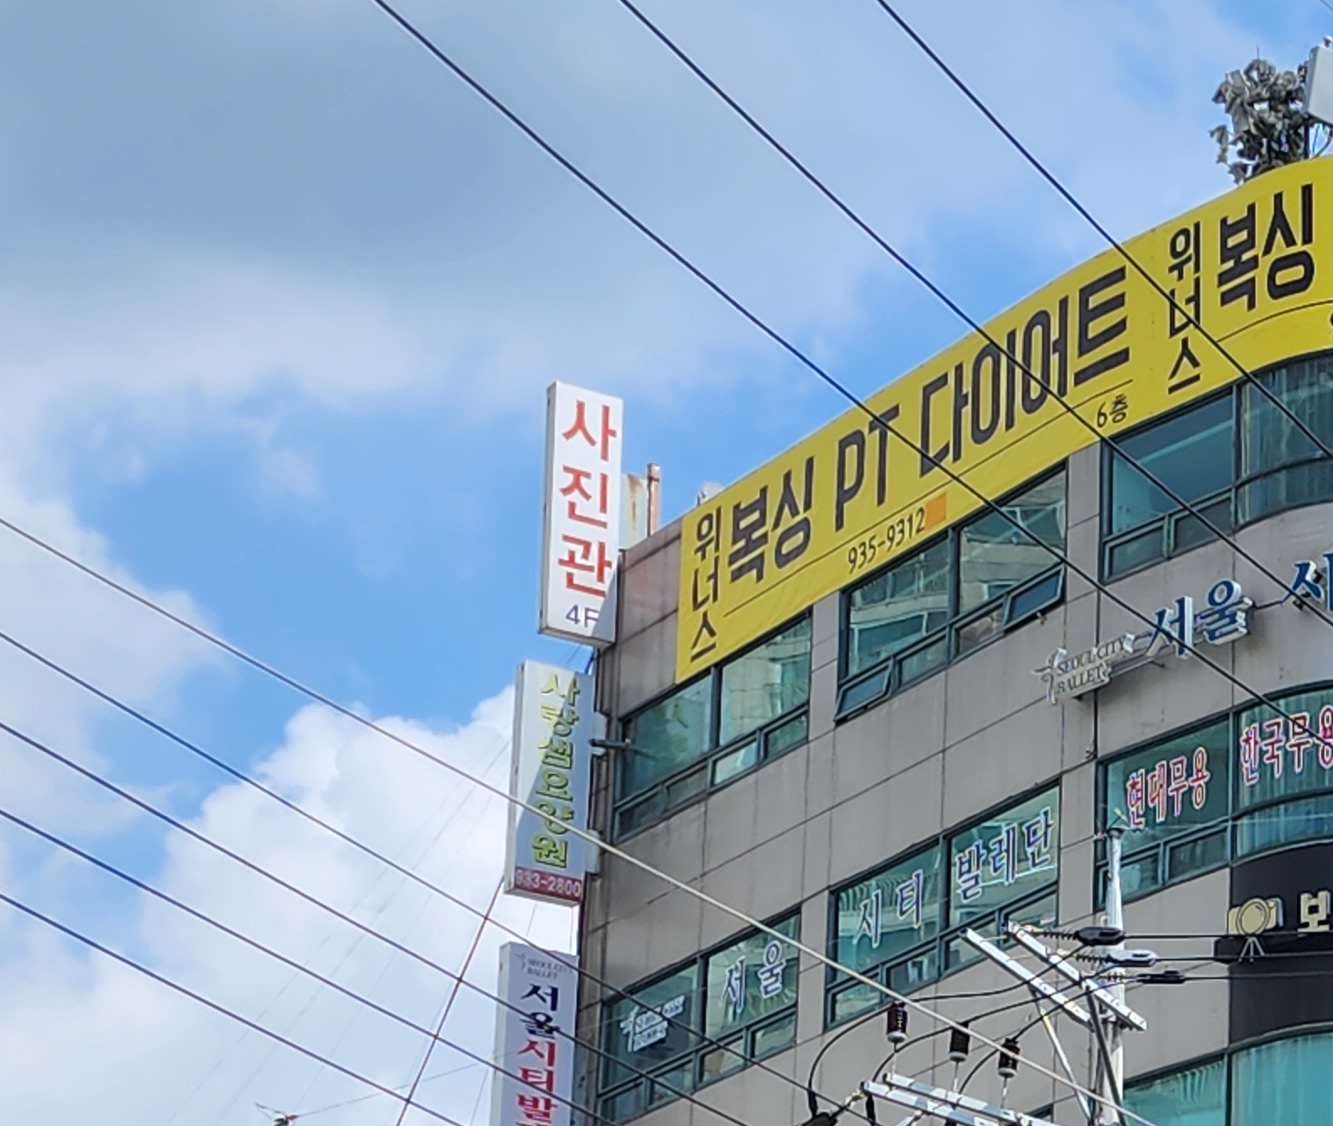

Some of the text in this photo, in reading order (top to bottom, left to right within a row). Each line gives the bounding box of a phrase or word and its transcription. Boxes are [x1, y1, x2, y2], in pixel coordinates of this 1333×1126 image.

[1167, 221, 1202, 395] 위너스
[1217, 183, 1315, 312] 복싱
[728, 264, 1131, 587] 복싱 PT 다이어트
[1095, 393, 1130, 430] 6층
[557, 398, 619, 600] 사진관
[846, 507, 927, 575] 935-9312
[565, 605, 600, 629] 4F
[690, 505, 723, 663] 위너스
[1146, 579, 1253, 660] 서울
[1126, 746, 1211, 830] 현대무용
[722, 940, 787, 1013] 서울
[955, 807, 1055, 903] 발레단
